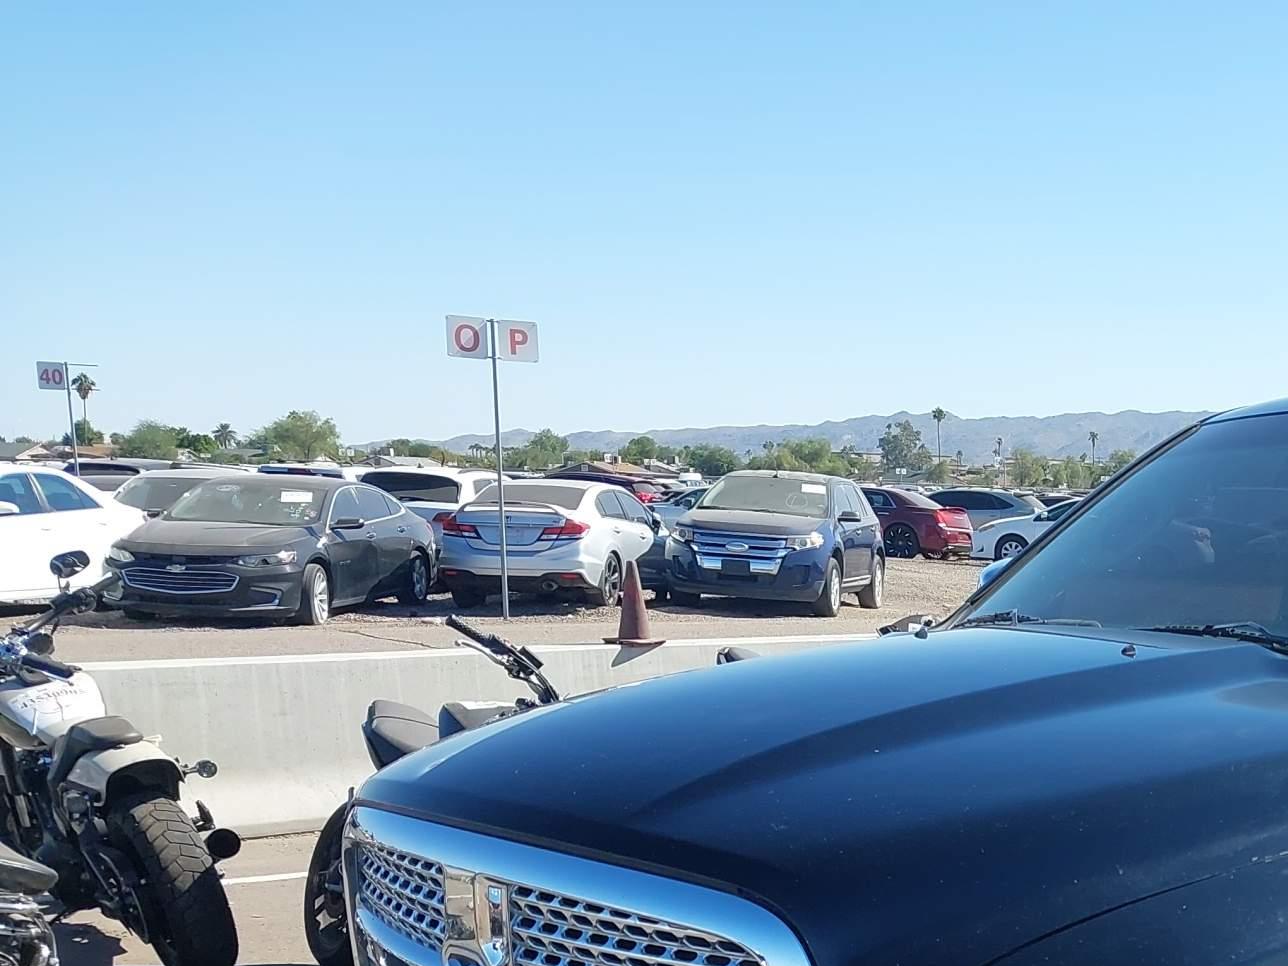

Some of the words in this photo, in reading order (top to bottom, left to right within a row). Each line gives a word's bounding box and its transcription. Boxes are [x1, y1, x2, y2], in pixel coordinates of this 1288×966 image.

[455, 323, 480, 352] O
[509, 328, 529, 355] P
[40, 368, 63, 385] 40
